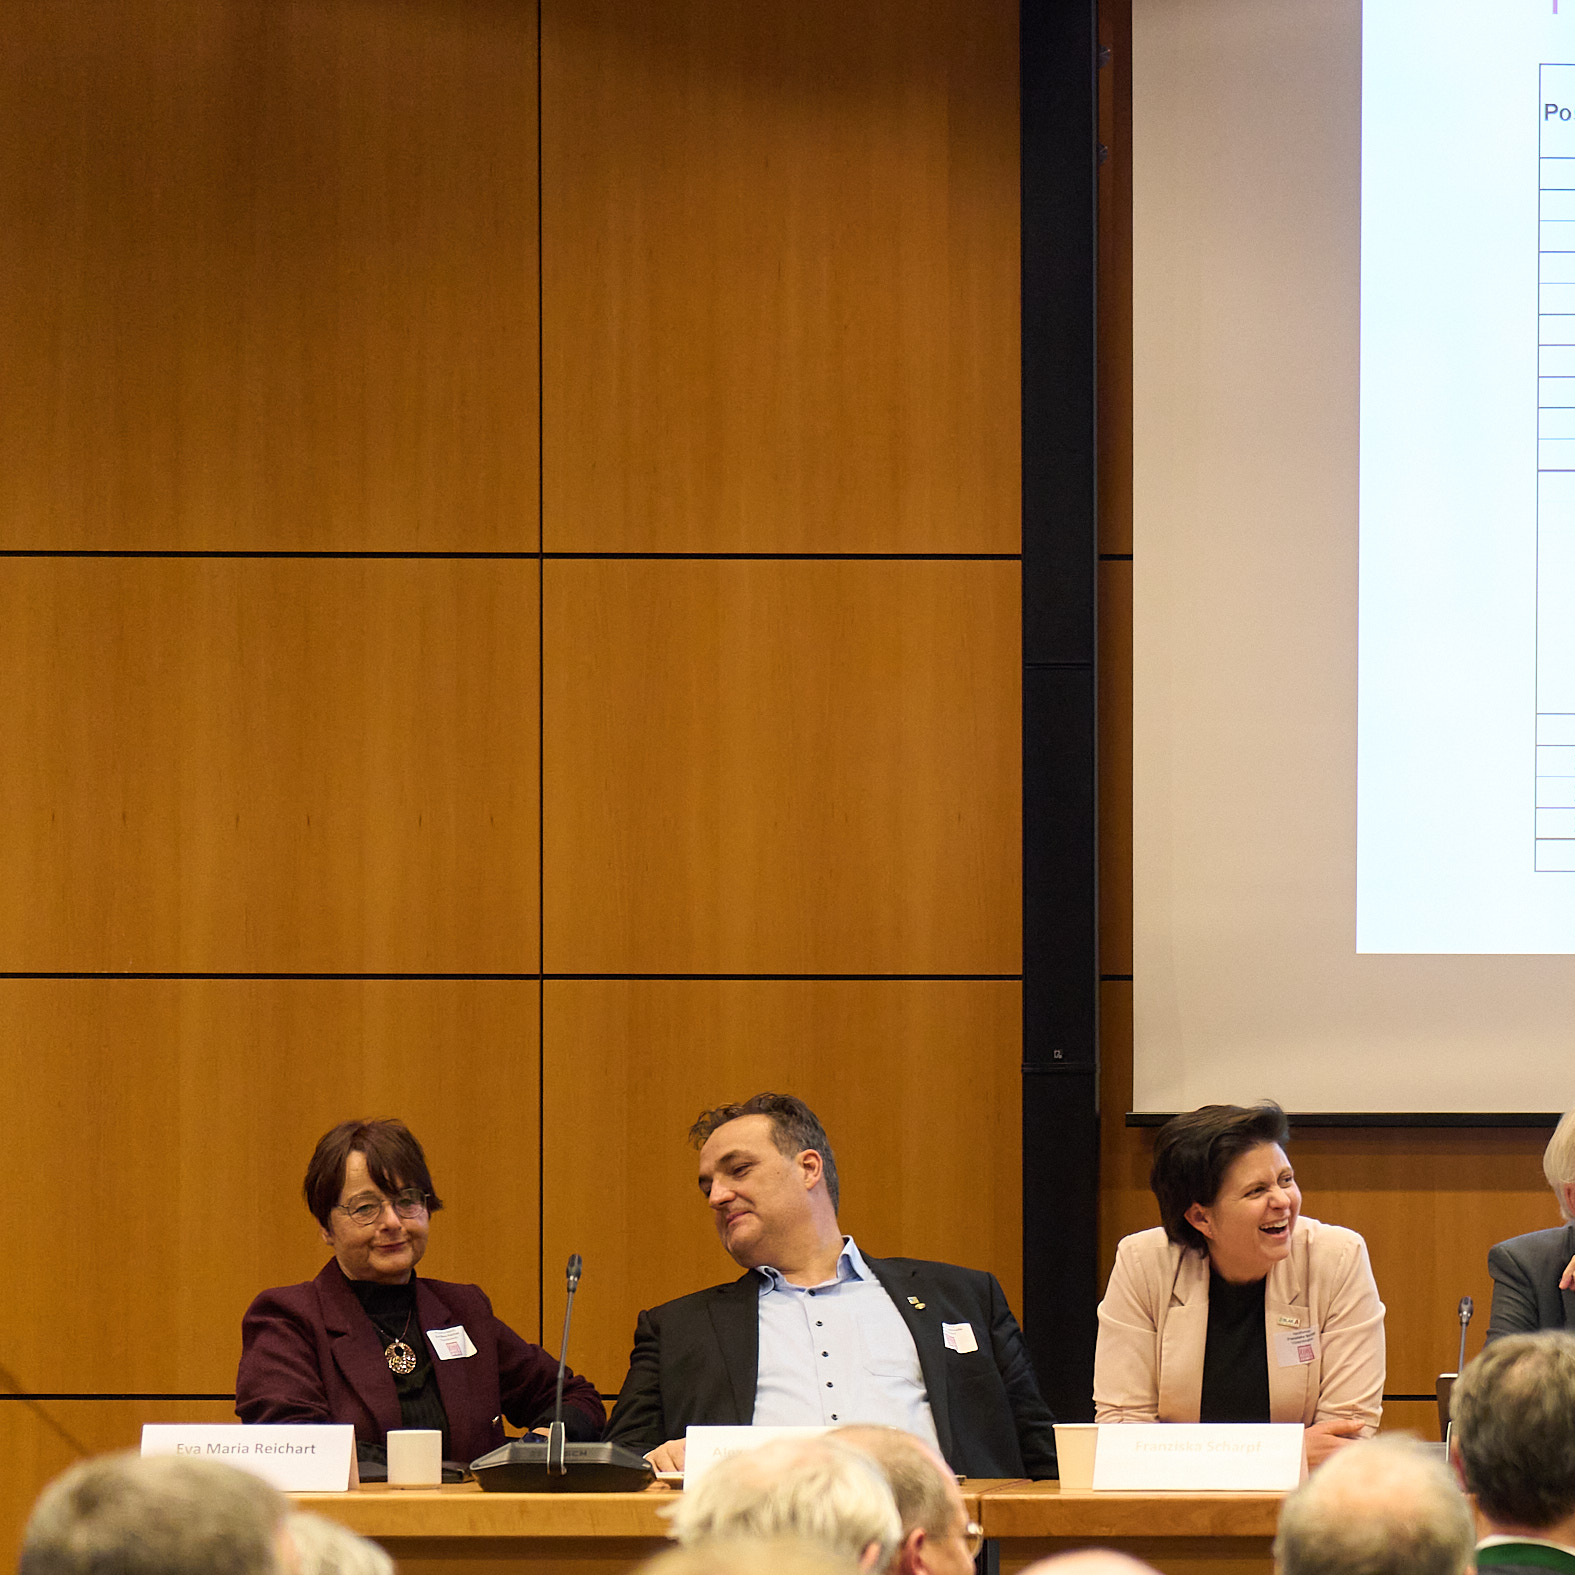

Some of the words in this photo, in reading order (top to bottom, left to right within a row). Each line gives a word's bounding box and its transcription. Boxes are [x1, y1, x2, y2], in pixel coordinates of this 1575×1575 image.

[176, 1443, 201, 1455] Eva
[206, 1442, 250, 1455] Maria
[254, 1442, 317, 1455] Reichart
[1135, 1440, 1203, 1452] Franziska
[1206, 1440, 1262, 1454] Scharpf
